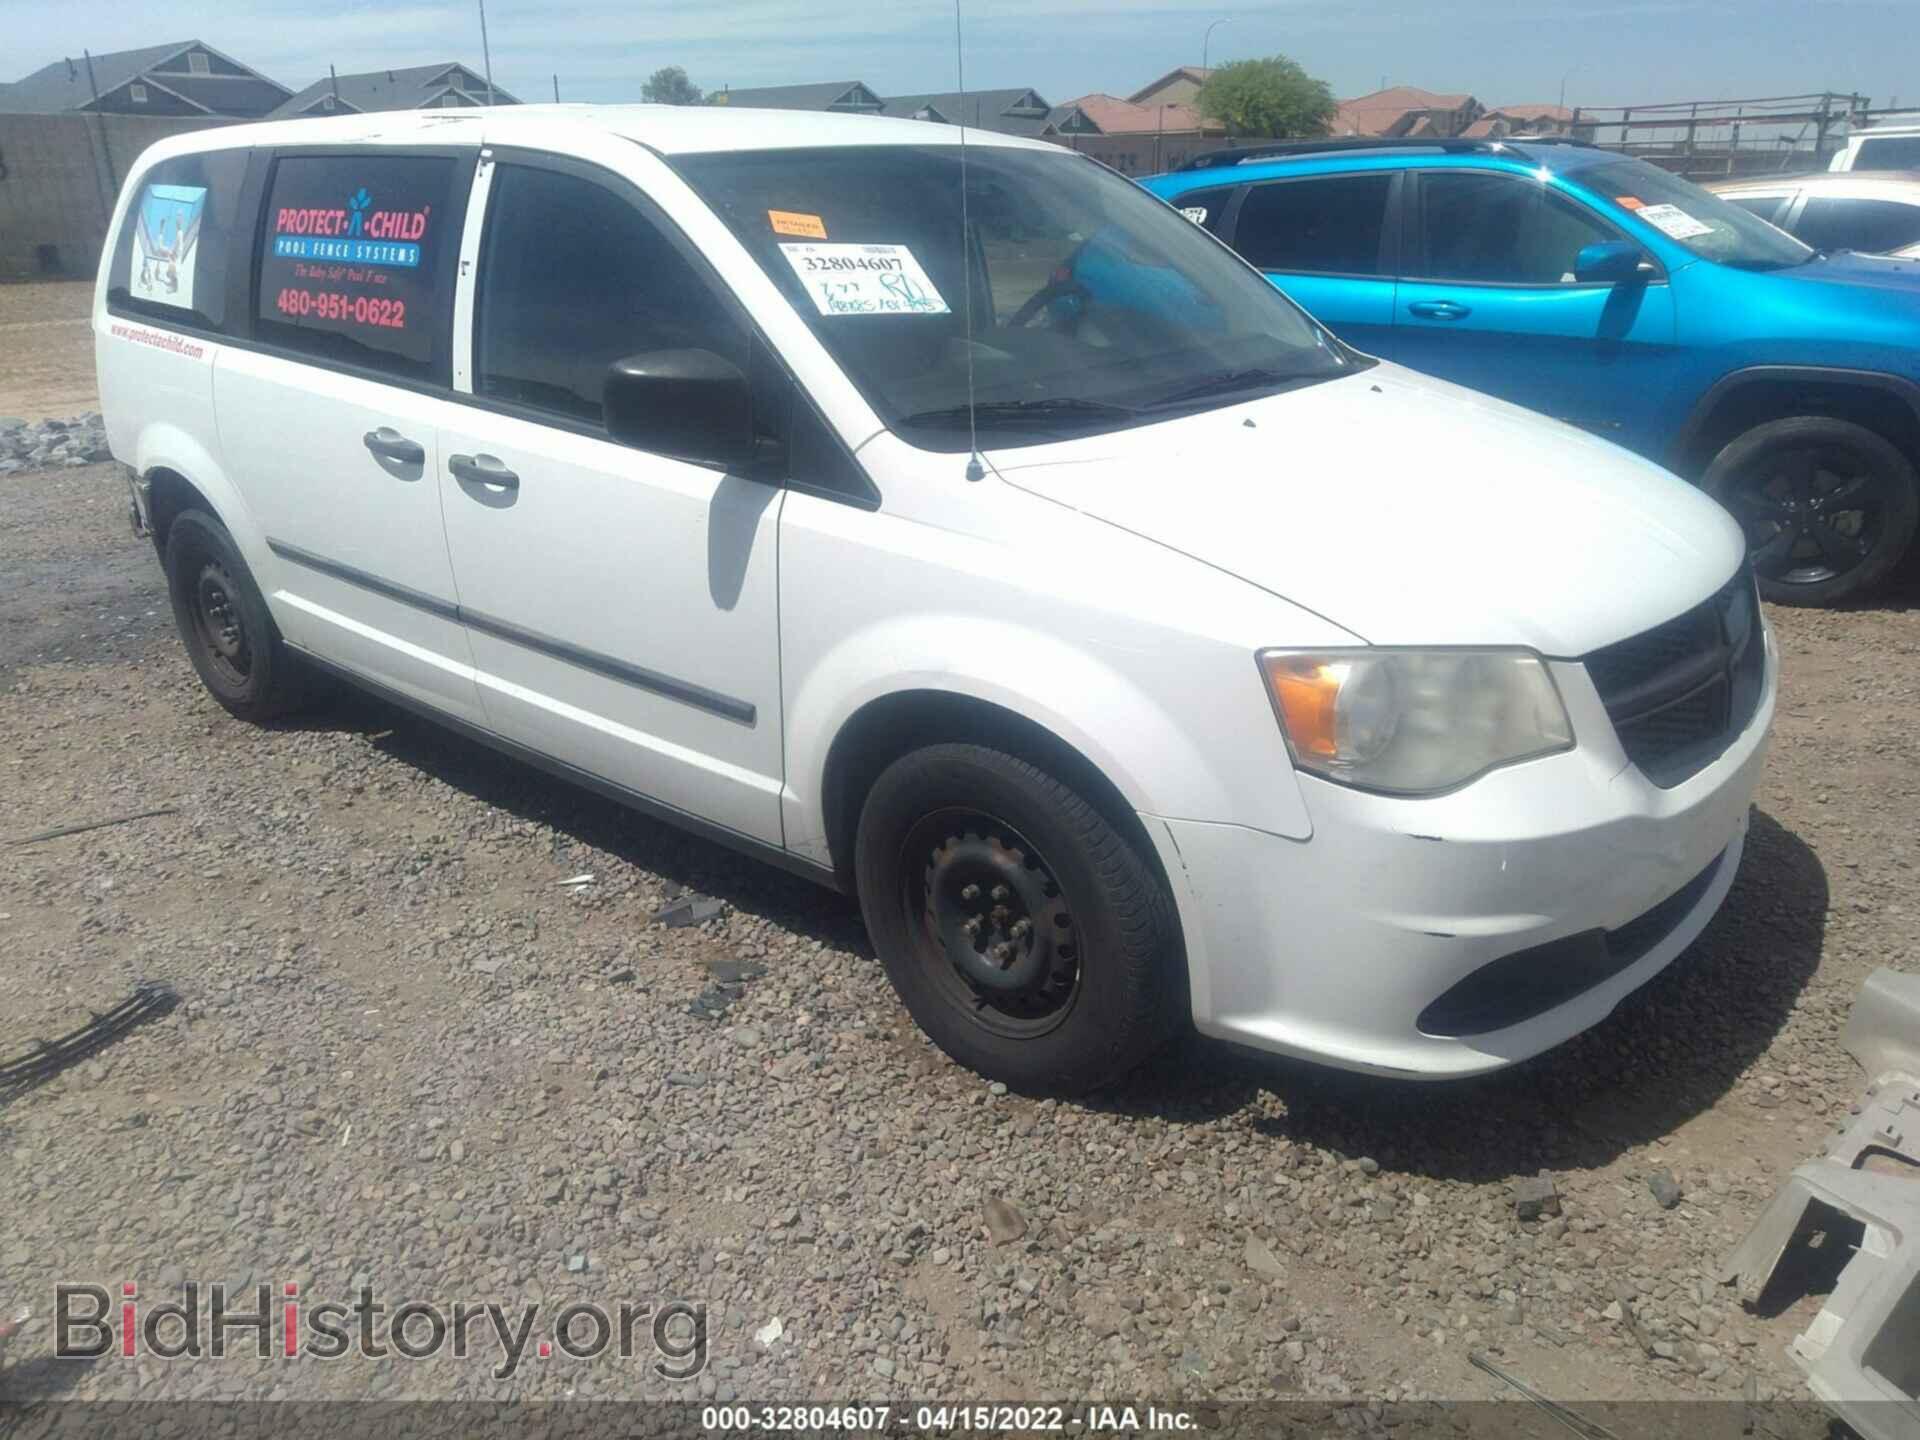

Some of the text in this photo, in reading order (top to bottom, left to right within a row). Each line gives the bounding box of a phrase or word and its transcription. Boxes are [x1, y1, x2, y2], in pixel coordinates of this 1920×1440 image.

[278, 240, 417, 263] POOL FENCE SYSTEMS
[803, 256, 903, 271] 32804607
[277, 288, 405, 328] 480-951-0622
[111, 324, 204, 359] www.protectachild.com
